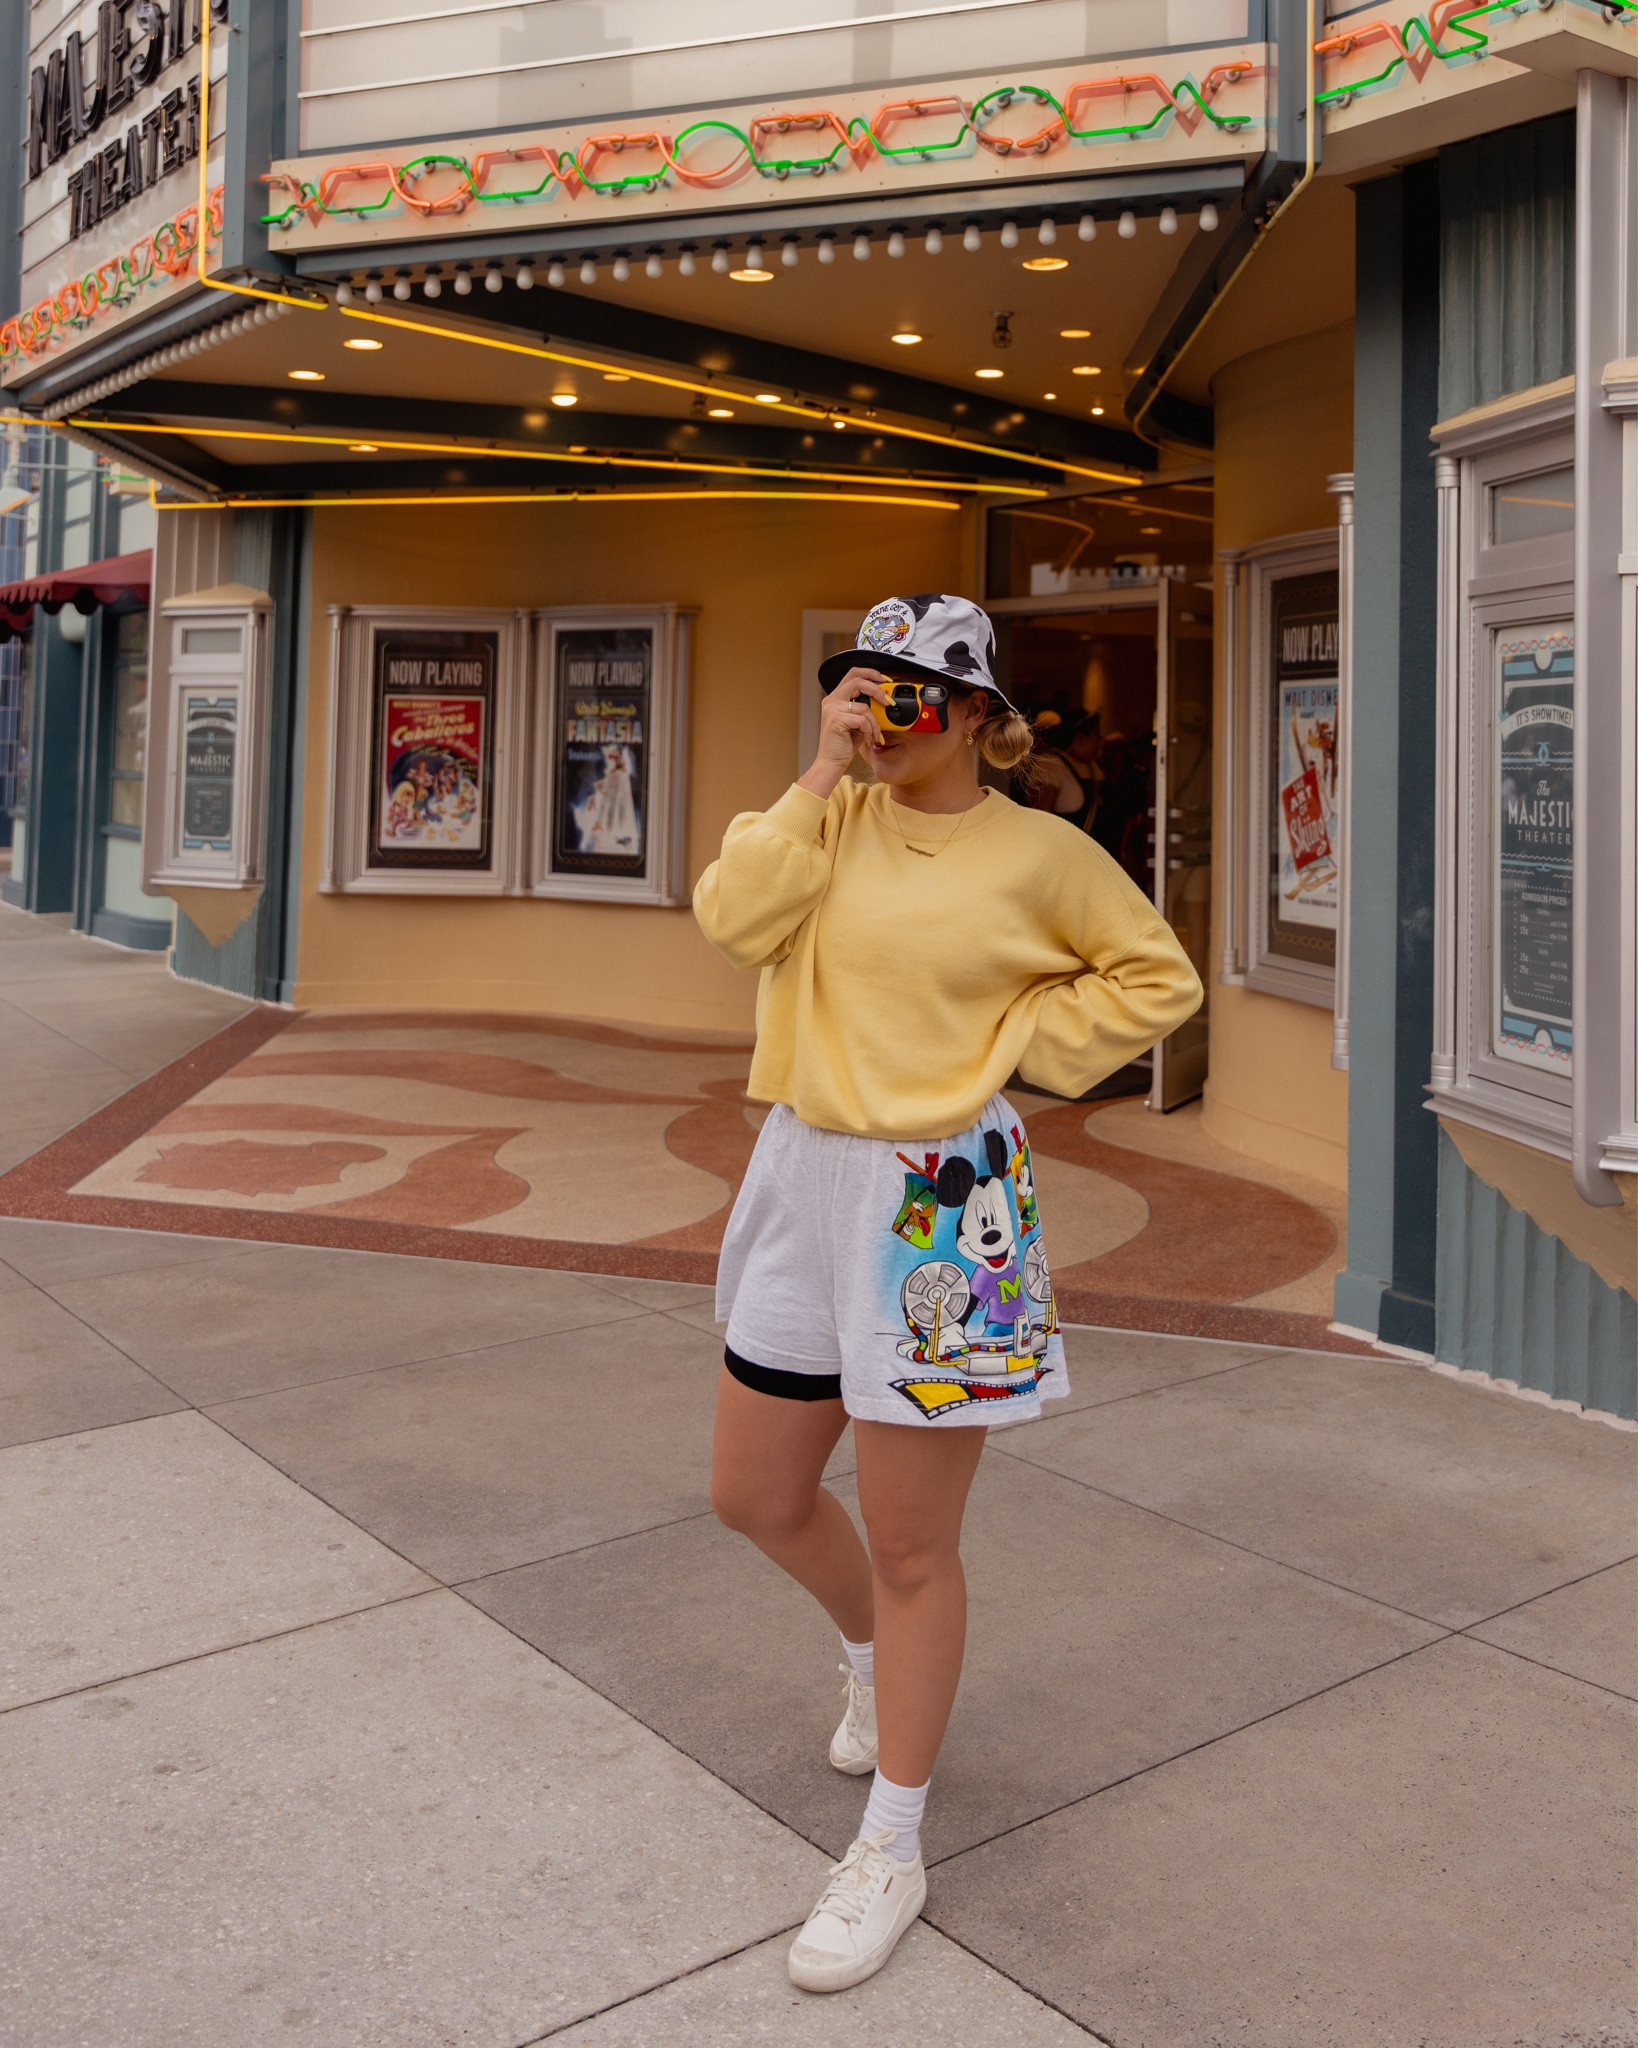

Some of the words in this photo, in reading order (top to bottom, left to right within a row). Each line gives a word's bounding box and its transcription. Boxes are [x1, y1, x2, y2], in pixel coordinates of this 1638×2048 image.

[890, 603, 904, 613] GOT
[901, 609, 909, 617] A
[1282, 625, 1310, 664] NOW
[389, 660, 422, 686] NOW
[425, 661, 483, 687] PLAYING
[569, 661, 596, 687] NOW
[597, 661, 643, 687] PLAYING
[1284, 690, 1306, 707] WALT
[427, 713, 466, 727] Three
[1515, 711, 1529, 727] IT'S
[1531, 707, 1572, 725] SHOWTIME!
[391, 722, 475, 748] Caballeros
[568, 720, 643, 744] FANTASIA
[190, 754, 231, 767] MAJESTIC
[1290, 784, 1312, 813] ART
[1536, 779, 1551, 796] The
[1289, 815, 1328, 859] Skiing
[1516, 829, 1571, 847] THEATER
[1521, 892, 1548, 904] ADMISSION
[1548, 895, 1567, 906] PRICES
[996, 1272, 1022, 1304] M
